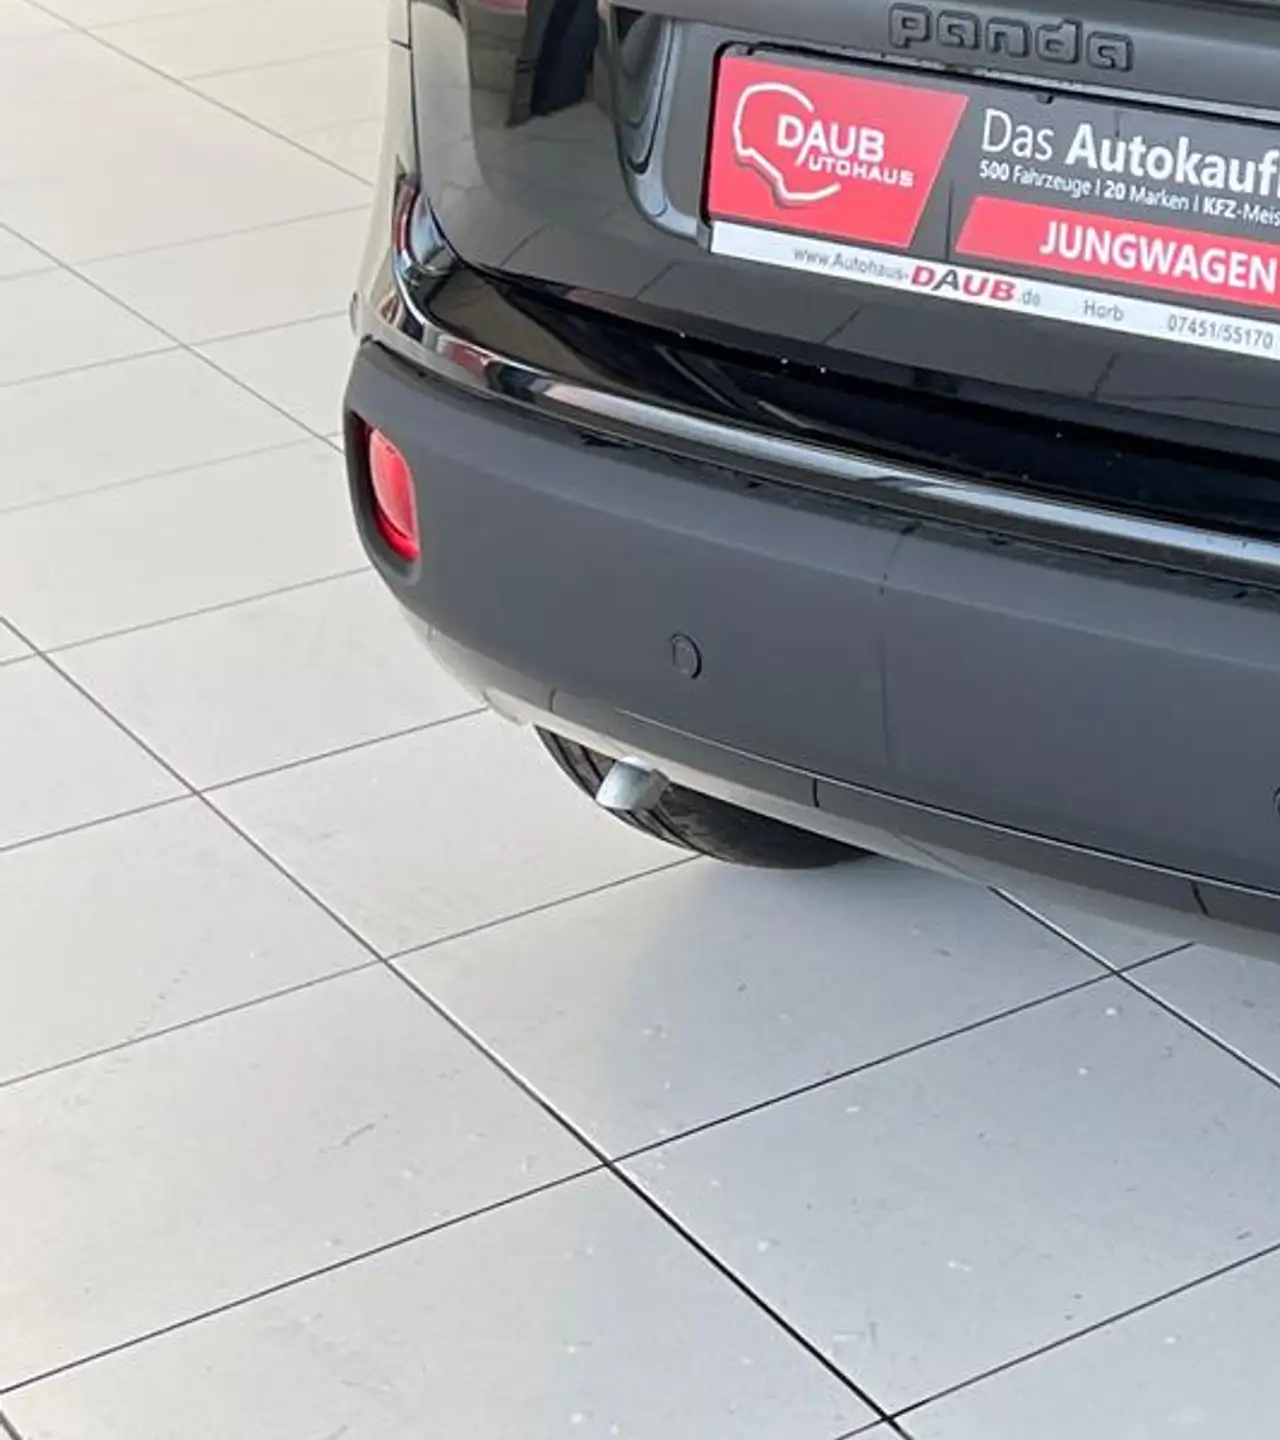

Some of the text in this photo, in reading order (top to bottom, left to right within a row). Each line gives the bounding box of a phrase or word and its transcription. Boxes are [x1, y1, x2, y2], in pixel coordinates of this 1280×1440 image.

[888, 2, 1133, 71] panda
[777, 114, 885, 166] DAUB
[981, 108, 1054, 160] Das
[979, 160, 1009, 181] 500
[1013, 165, 1092, 198] Fahrzeuge
[1104, 180, 1126, 200] 20
[1129, 185, 1189, 210] Marken
[1039, 221, 1279, 294] JUNGWAGEN
[1083, 299, 1124, 322] Horb
[1168, 314, 1275, 350] 07451/55170
